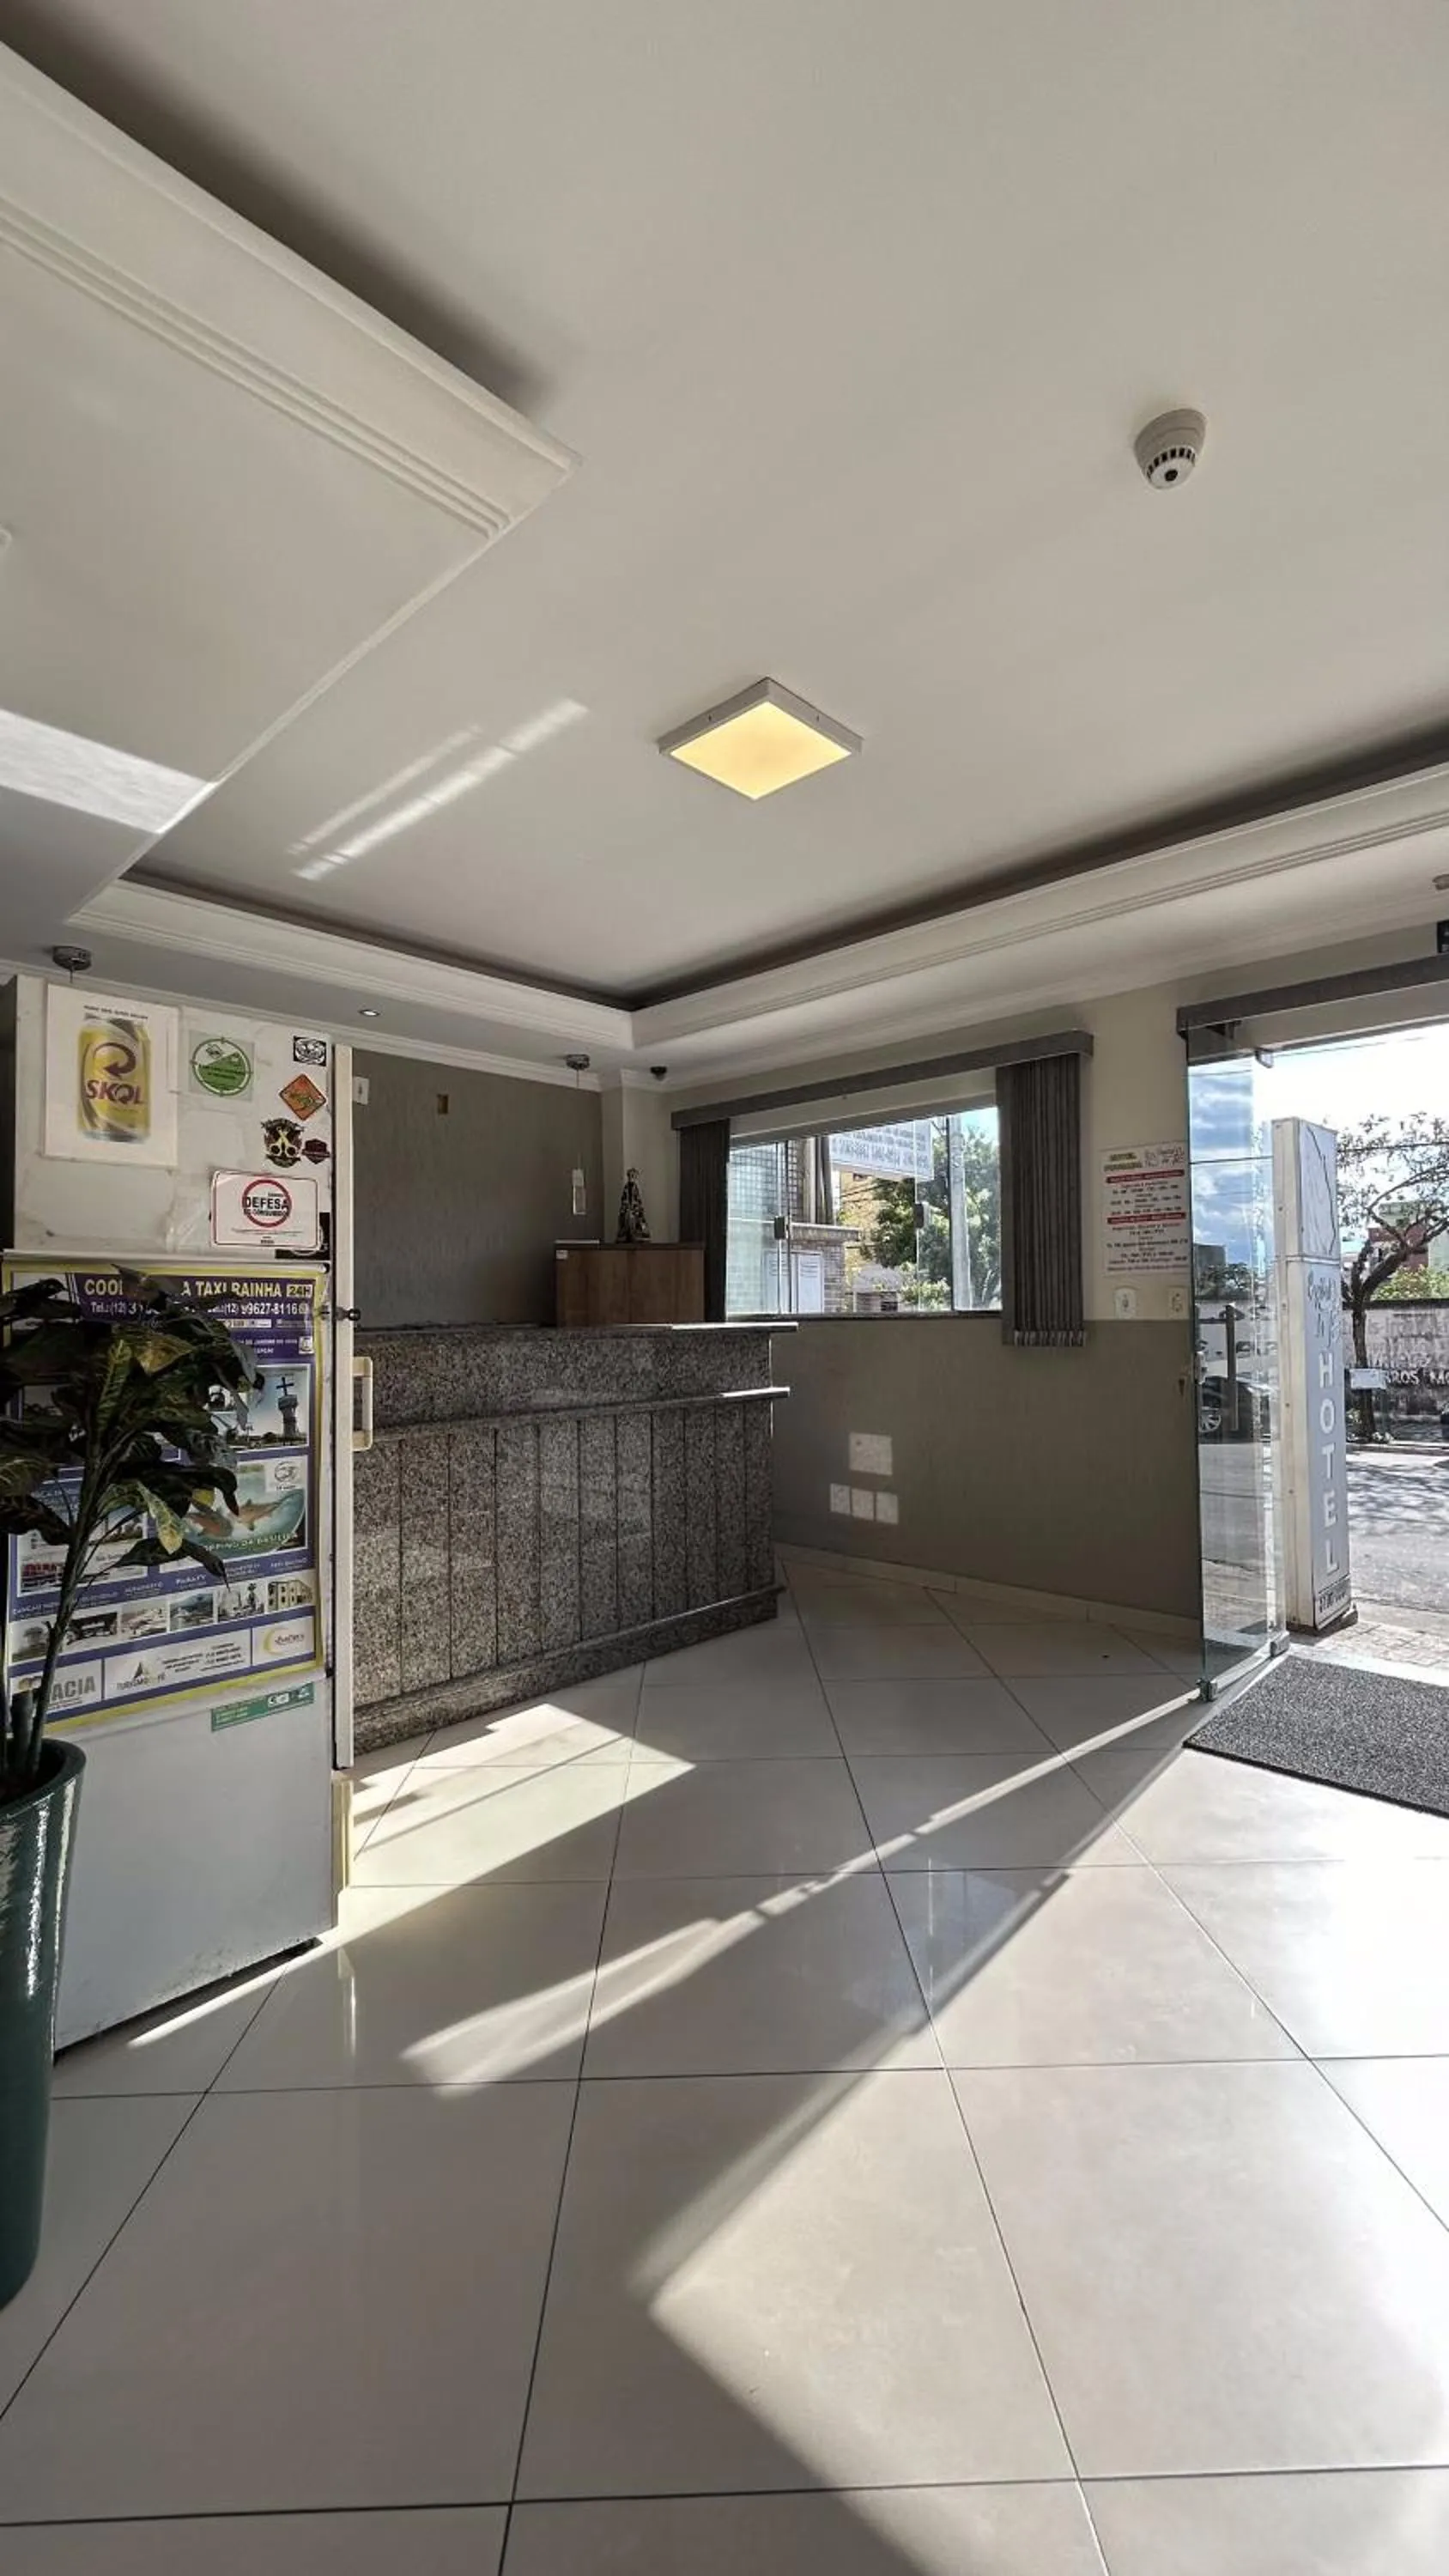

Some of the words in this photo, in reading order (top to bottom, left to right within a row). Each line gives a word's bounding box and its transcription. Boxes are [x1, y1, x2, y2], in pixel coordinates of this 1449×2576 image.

[86, 1079, 144, 1105] SKOL
[243, 1196, 289, 1210] DEFESA
[195, 1280, 227, 1297] TAXI
[231, 1281, 282, 1297] RAINHA
[1319, 1352, 1339, 1574] HOTEL
[50, 1674, 97, 1702] ACIA
